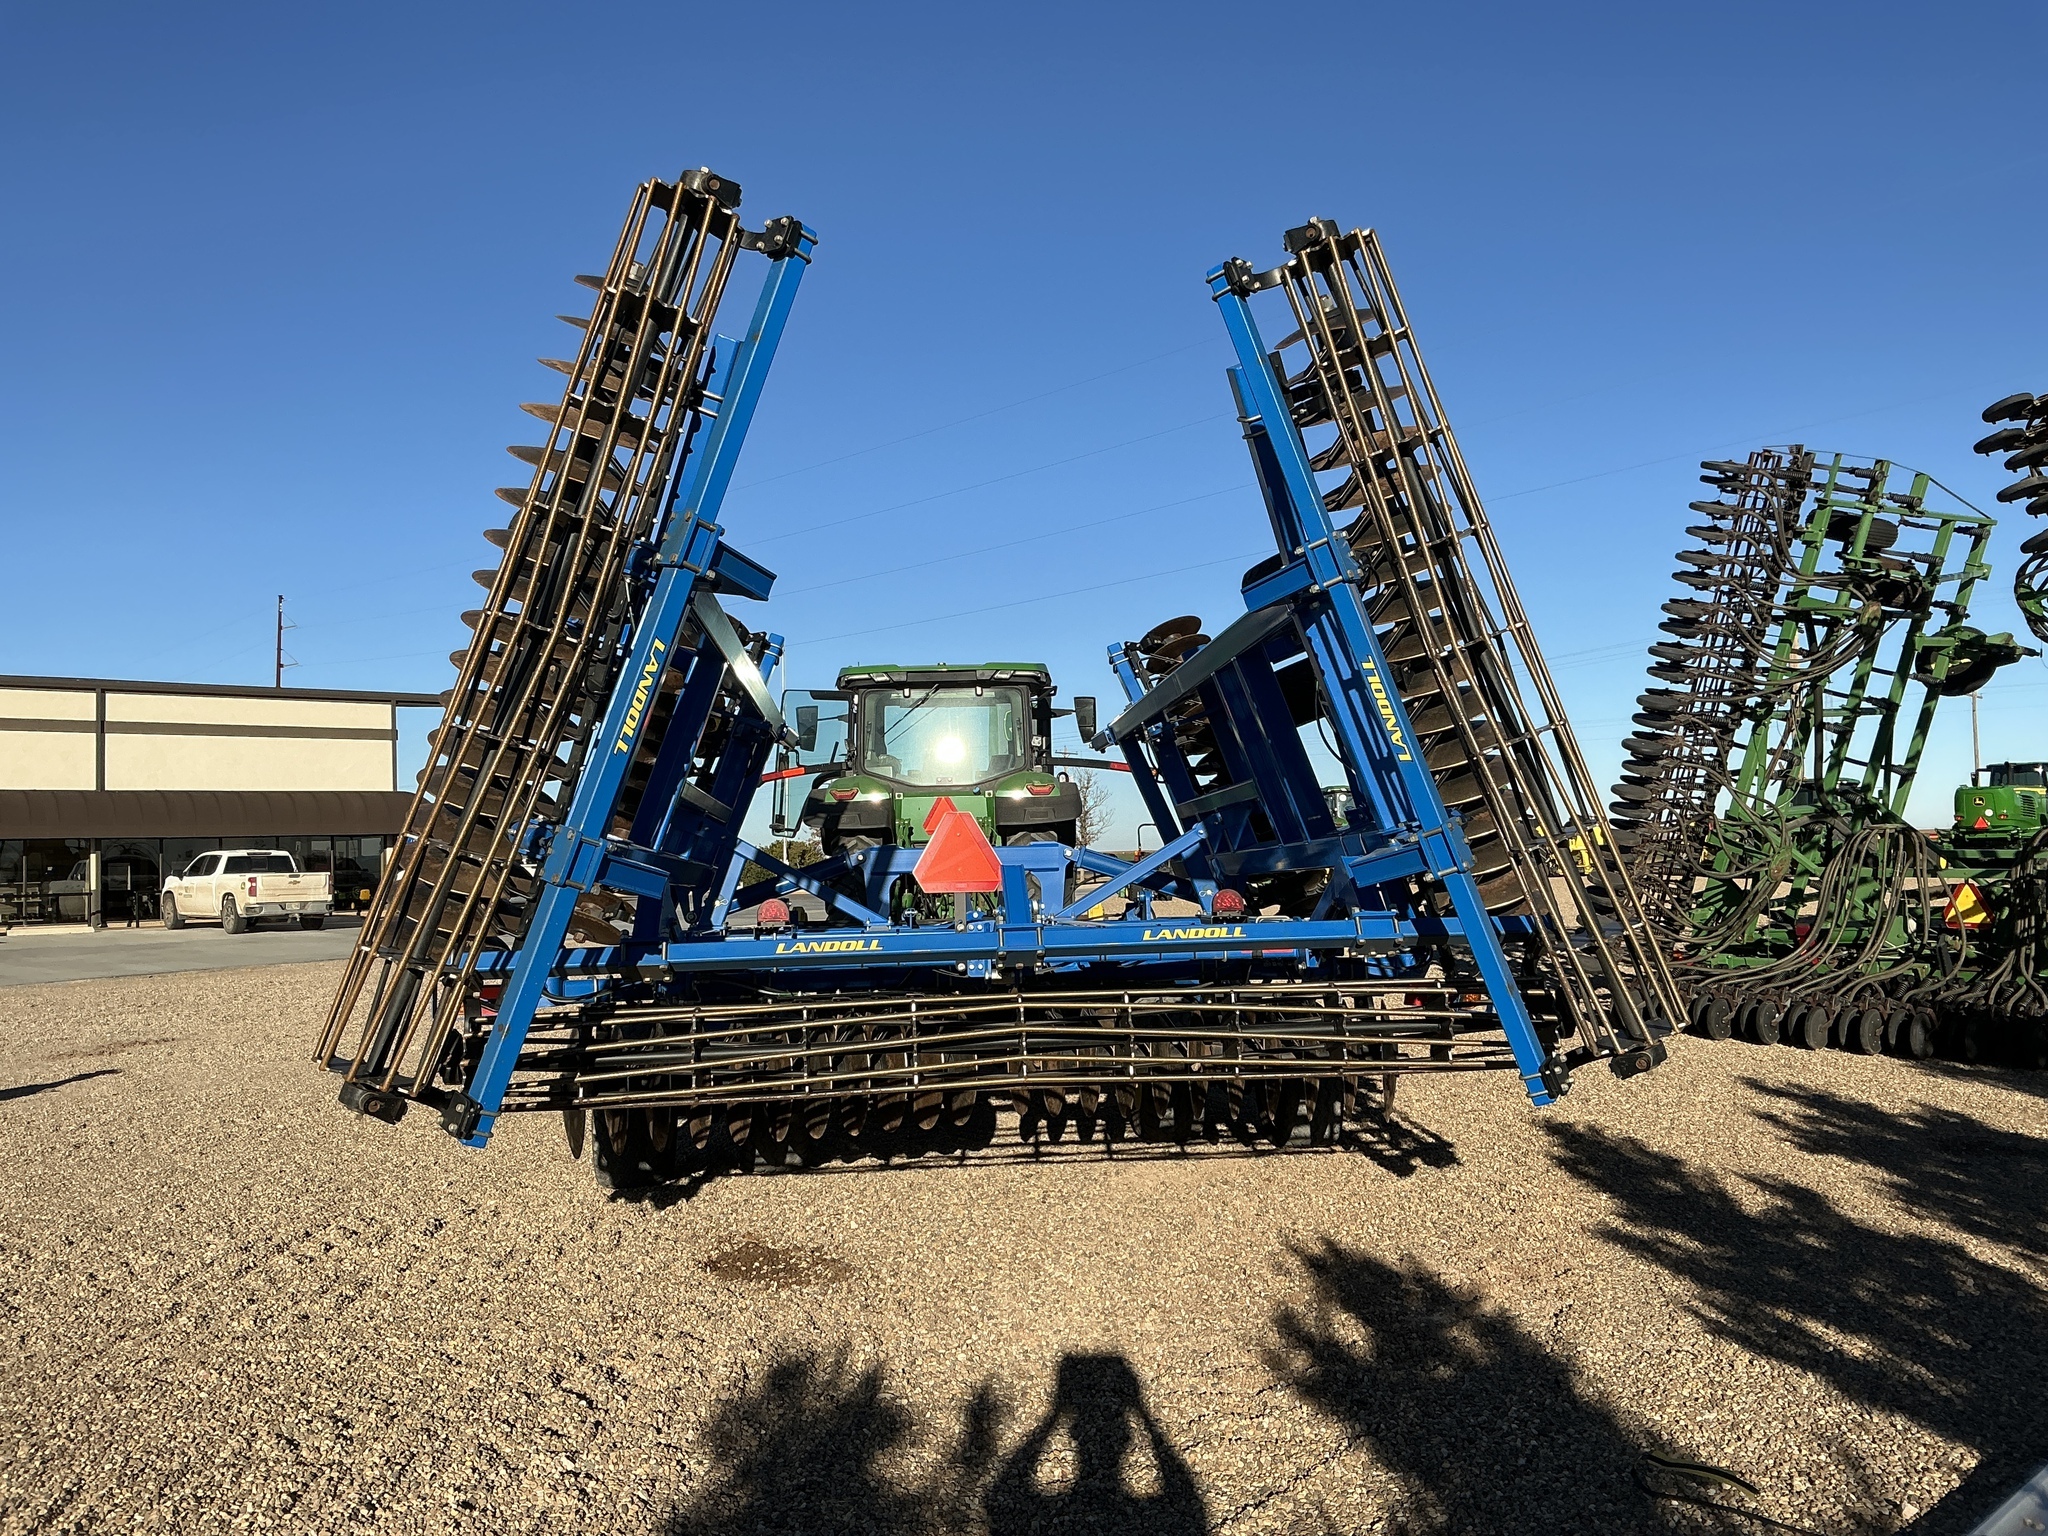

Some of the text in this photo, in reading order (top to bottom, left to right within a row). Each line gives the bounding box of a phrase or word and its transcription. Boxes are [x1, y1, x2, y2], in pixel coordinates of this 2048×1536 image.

[613, 637, 666, 755] LANDOLL
[1361, 655, 1412, 761] LANDOLL
[775, 939, 884, 955] LANDOLL
[1142, 926, 1247, 941] LANDOLL
